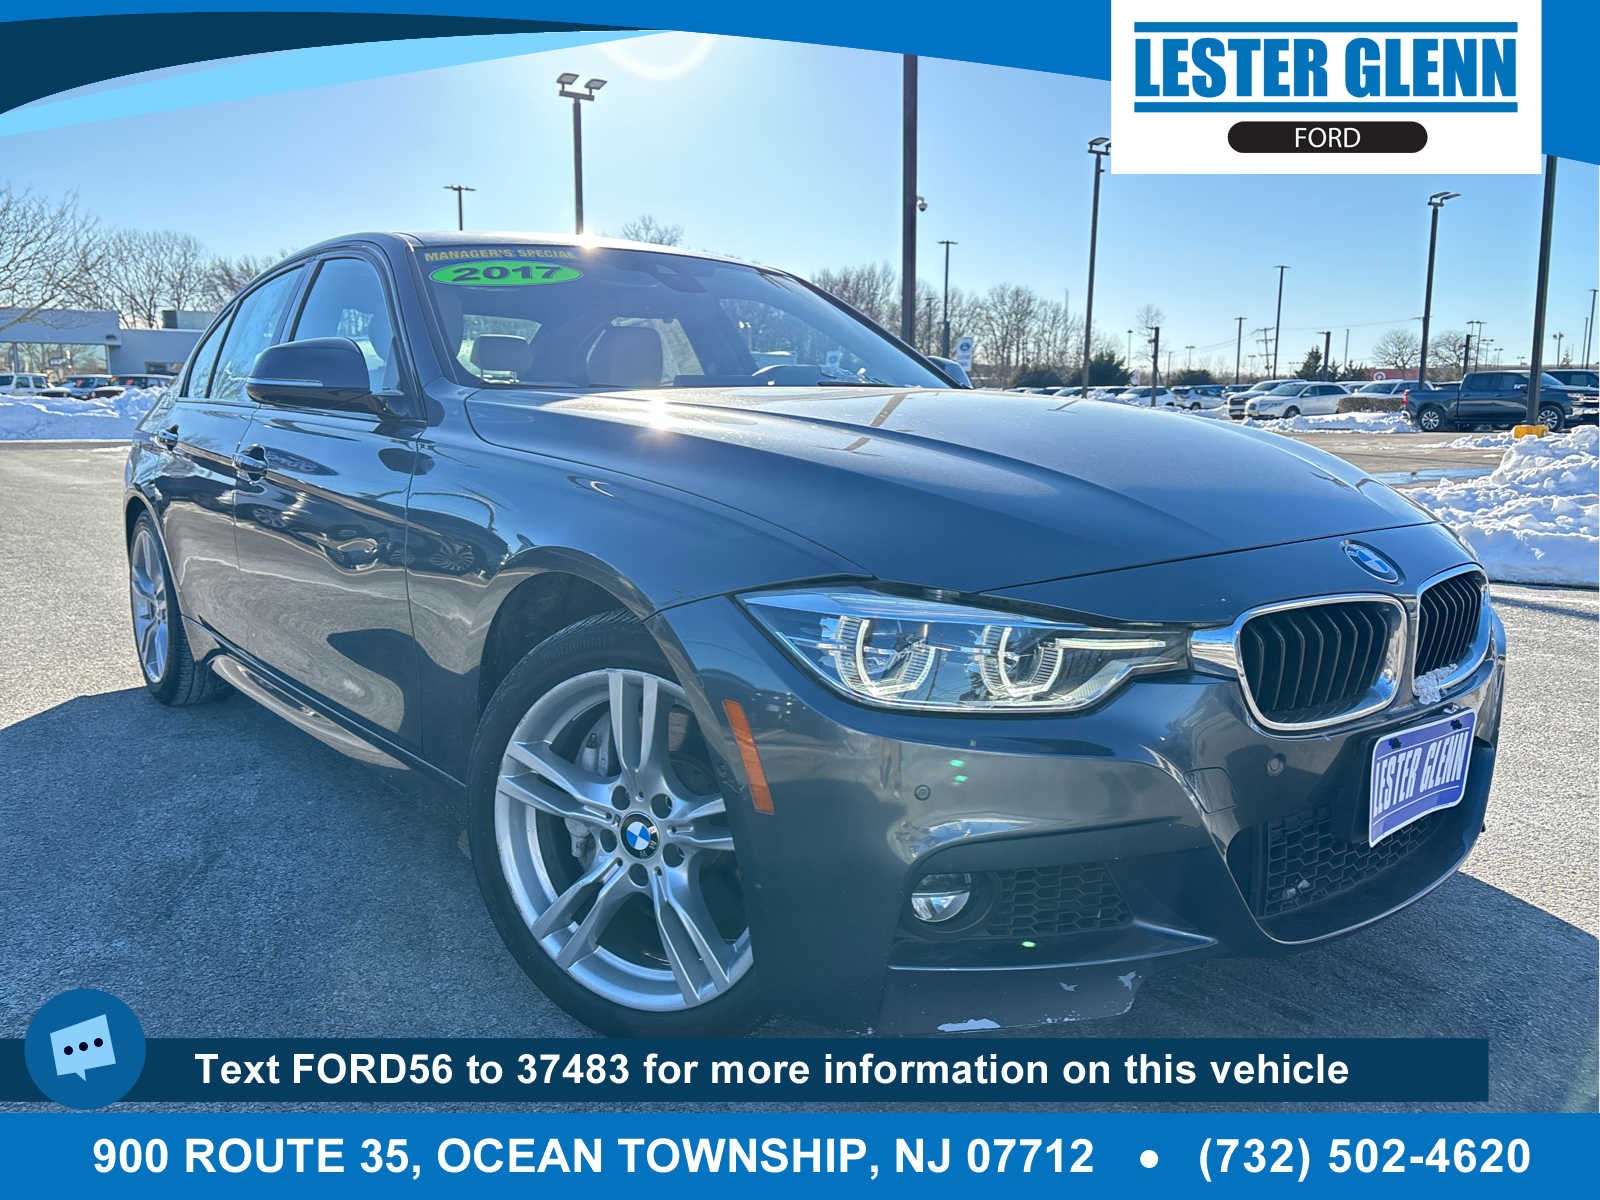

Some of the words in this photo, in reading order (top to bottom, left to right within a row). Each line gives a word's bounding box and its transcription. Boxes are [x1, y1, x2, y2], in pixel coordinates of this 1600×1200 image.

[424, 249, 513, 262] MANAGER'S
[518, 249, 577, 259] SPECIAL
[452, 265, 561, 282] 2017
[1373, 747, 1422, 818] LESTER
[1420, 731, 1469, 792] GLENN
